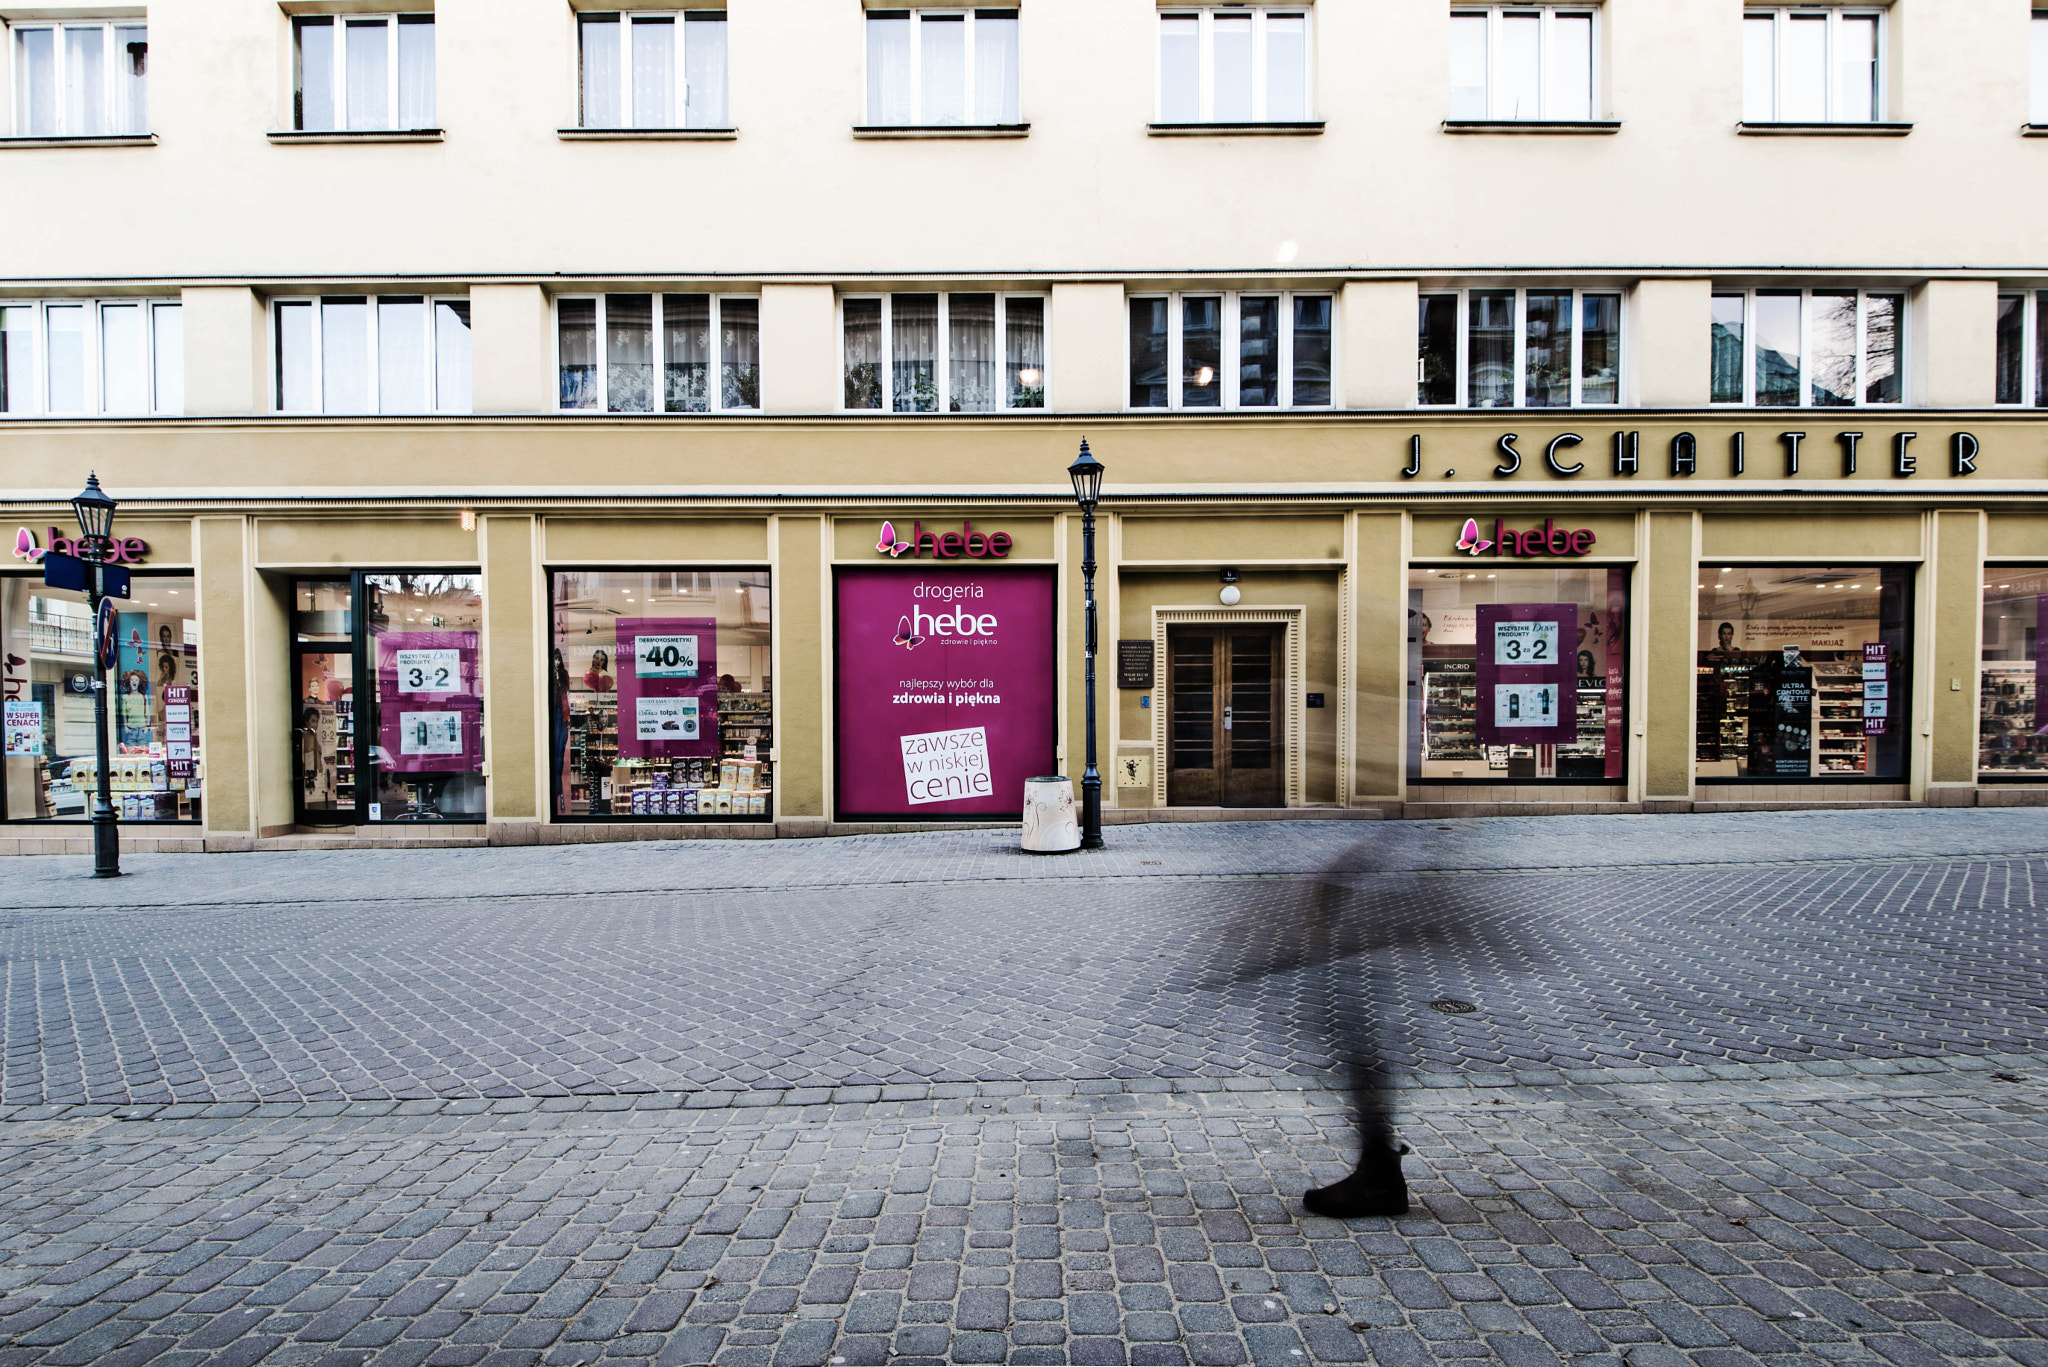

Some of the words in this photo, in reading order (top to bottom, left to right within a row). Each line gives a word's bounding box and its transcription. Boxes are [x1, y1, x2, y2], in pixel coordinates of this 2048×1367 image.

[1402, 433, 1456, 477] J.
[1495, 431, 1980, 477] SCHAITTER
[914, 520, 1013, 558] hebe
[1495, 518, 1597, 556] hebe
[913, 581, 984, 602] drogeria
[913, 604, 998, 636] hebe
[1532, 623, 1556, 632] Dove
[940, 638, 969, 646] zdrowie
[973, 638, 998, 647] piękno
[1506, 639, 1522, 660] 3
[1532, 639, 1547, 660] 2
[1866, 645, 1886, 655] HIT
[639, 645, 693, 667] -40%
[408, 667, 424, 688] 3
[434, 667, 449, 687] 2
[899, 678, 944, 690] najlepszy
[946, 678, 977, 690] wybór
[979, 678, 994, 688] dla
[167, 687, 188, 698] HIT
[892, 692, 945, 704] zdrowia
[948, 692, 952, 704] i
[955, 692, 1001, 706] piękna
[6, 719, 40, 727] CENACH
[1865, 718, 1885, 729] HIT
[904, 729, 984, 756] zawsze
[170, 761, 190, 771] HIT
[907, 759, 923, 774] w
[929, 749, 984, 771] niskiej
[909, 768, 990, 800] cenie
